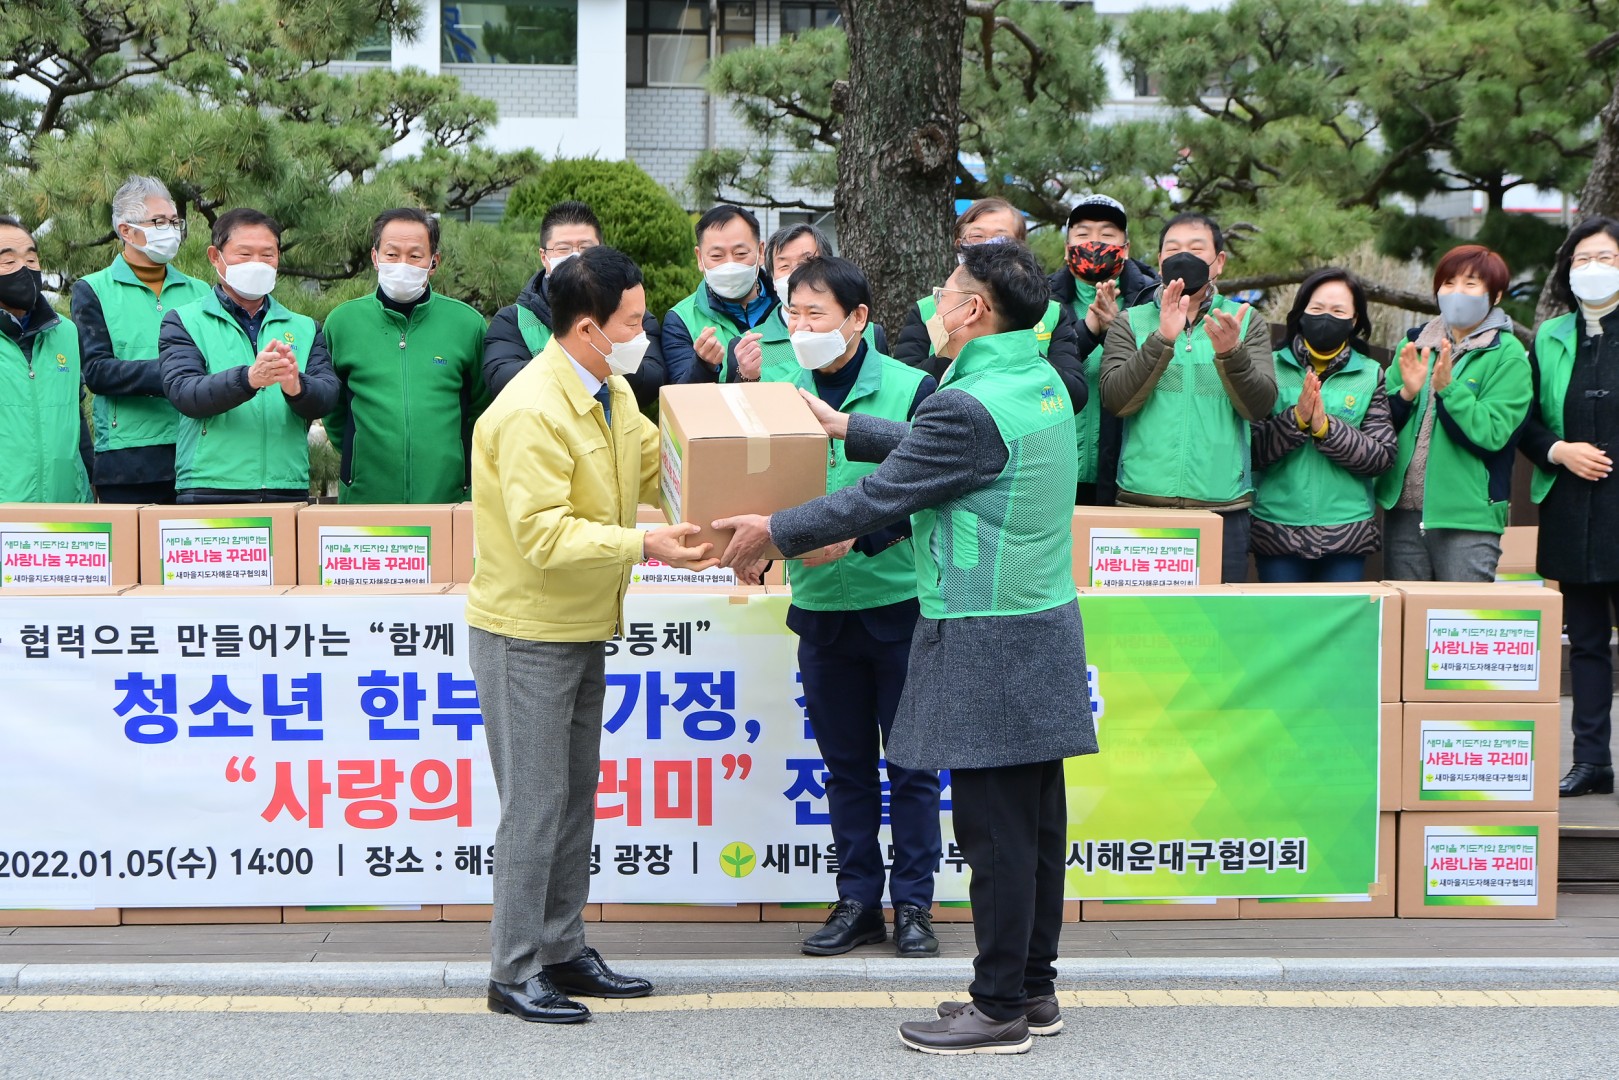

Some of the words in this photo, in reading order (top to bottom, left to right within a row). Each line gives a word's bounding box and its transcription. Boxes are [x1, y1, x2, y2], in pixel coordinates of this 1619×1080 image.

[5, 553, 61, 567] 사랑나눔
[65, 553, 106, 567] 꾸러미
[166, 549, 222, 563] 사랑나눔
[226, 548, 267, 562] 꾸러미
[325, 557, 381, 570] 사랑나눔
[384, 557, 425, 570] 꾸러미
[1095, 558, 1150, 572] 사랑나눔
[1154, 559, 1194, 572] 꾸러미
[20, 624, 159, 659] 협력으로
[177, 623, 351, 658] 만들어가는
[369, 621, 454, 657] “함께
[1432, 641, 1489, 655] 사랑나눔
[1493, 641, 1534, 655] 꾸러미
[113, 671, 324, 745] 청소년
[357, 669, 485, 741] 한부
[604, 670, 761, 744] 가정,
[1426, 752, 1483, 766] 사랑나눔
[1487, 752, 1528, 766] 꾸러미
[225, 756, 473, 830] “사랑의
[594, 754, 752, 827] 러미”
[0, 847, 217, 880] 2022.01.05(수)
[230, 847, 314, 876] 14:00
[365, 845, 424, 877] 장소
[613, 844, 673, 876] 광장
[1430, 857, 1487, 871] 사랑나눔
[1492, 857, 1533, 871] 꾸러미
